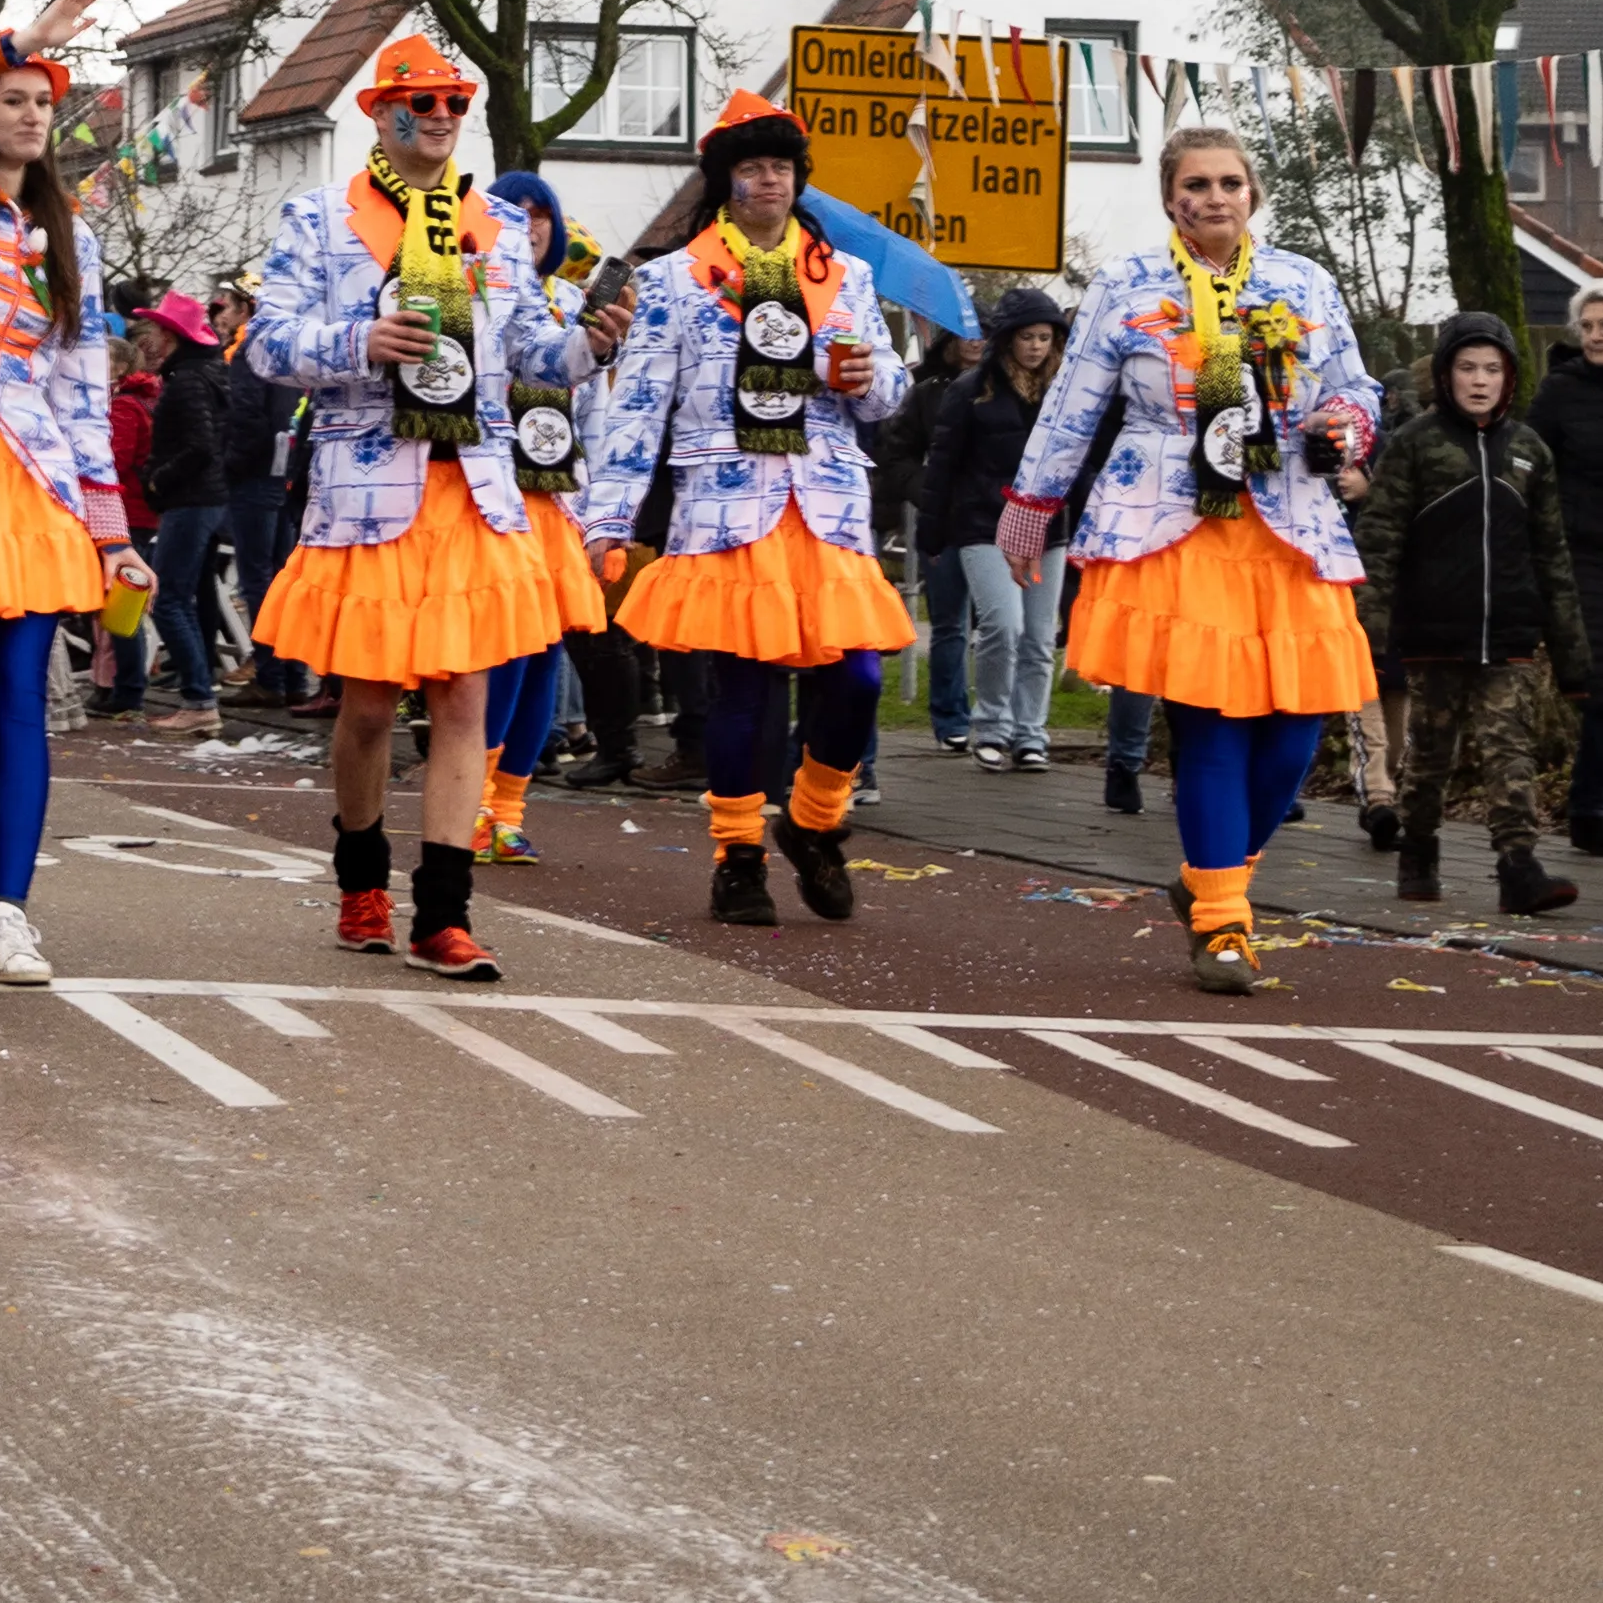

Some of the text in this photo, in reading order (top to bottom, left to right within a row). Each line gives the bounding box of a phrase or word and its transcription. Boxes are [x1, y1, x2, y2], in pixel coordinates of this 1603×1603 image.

[799, 97, 1056, 145] Van Botzelaer-
[972, 155, 1042, 196] laan
